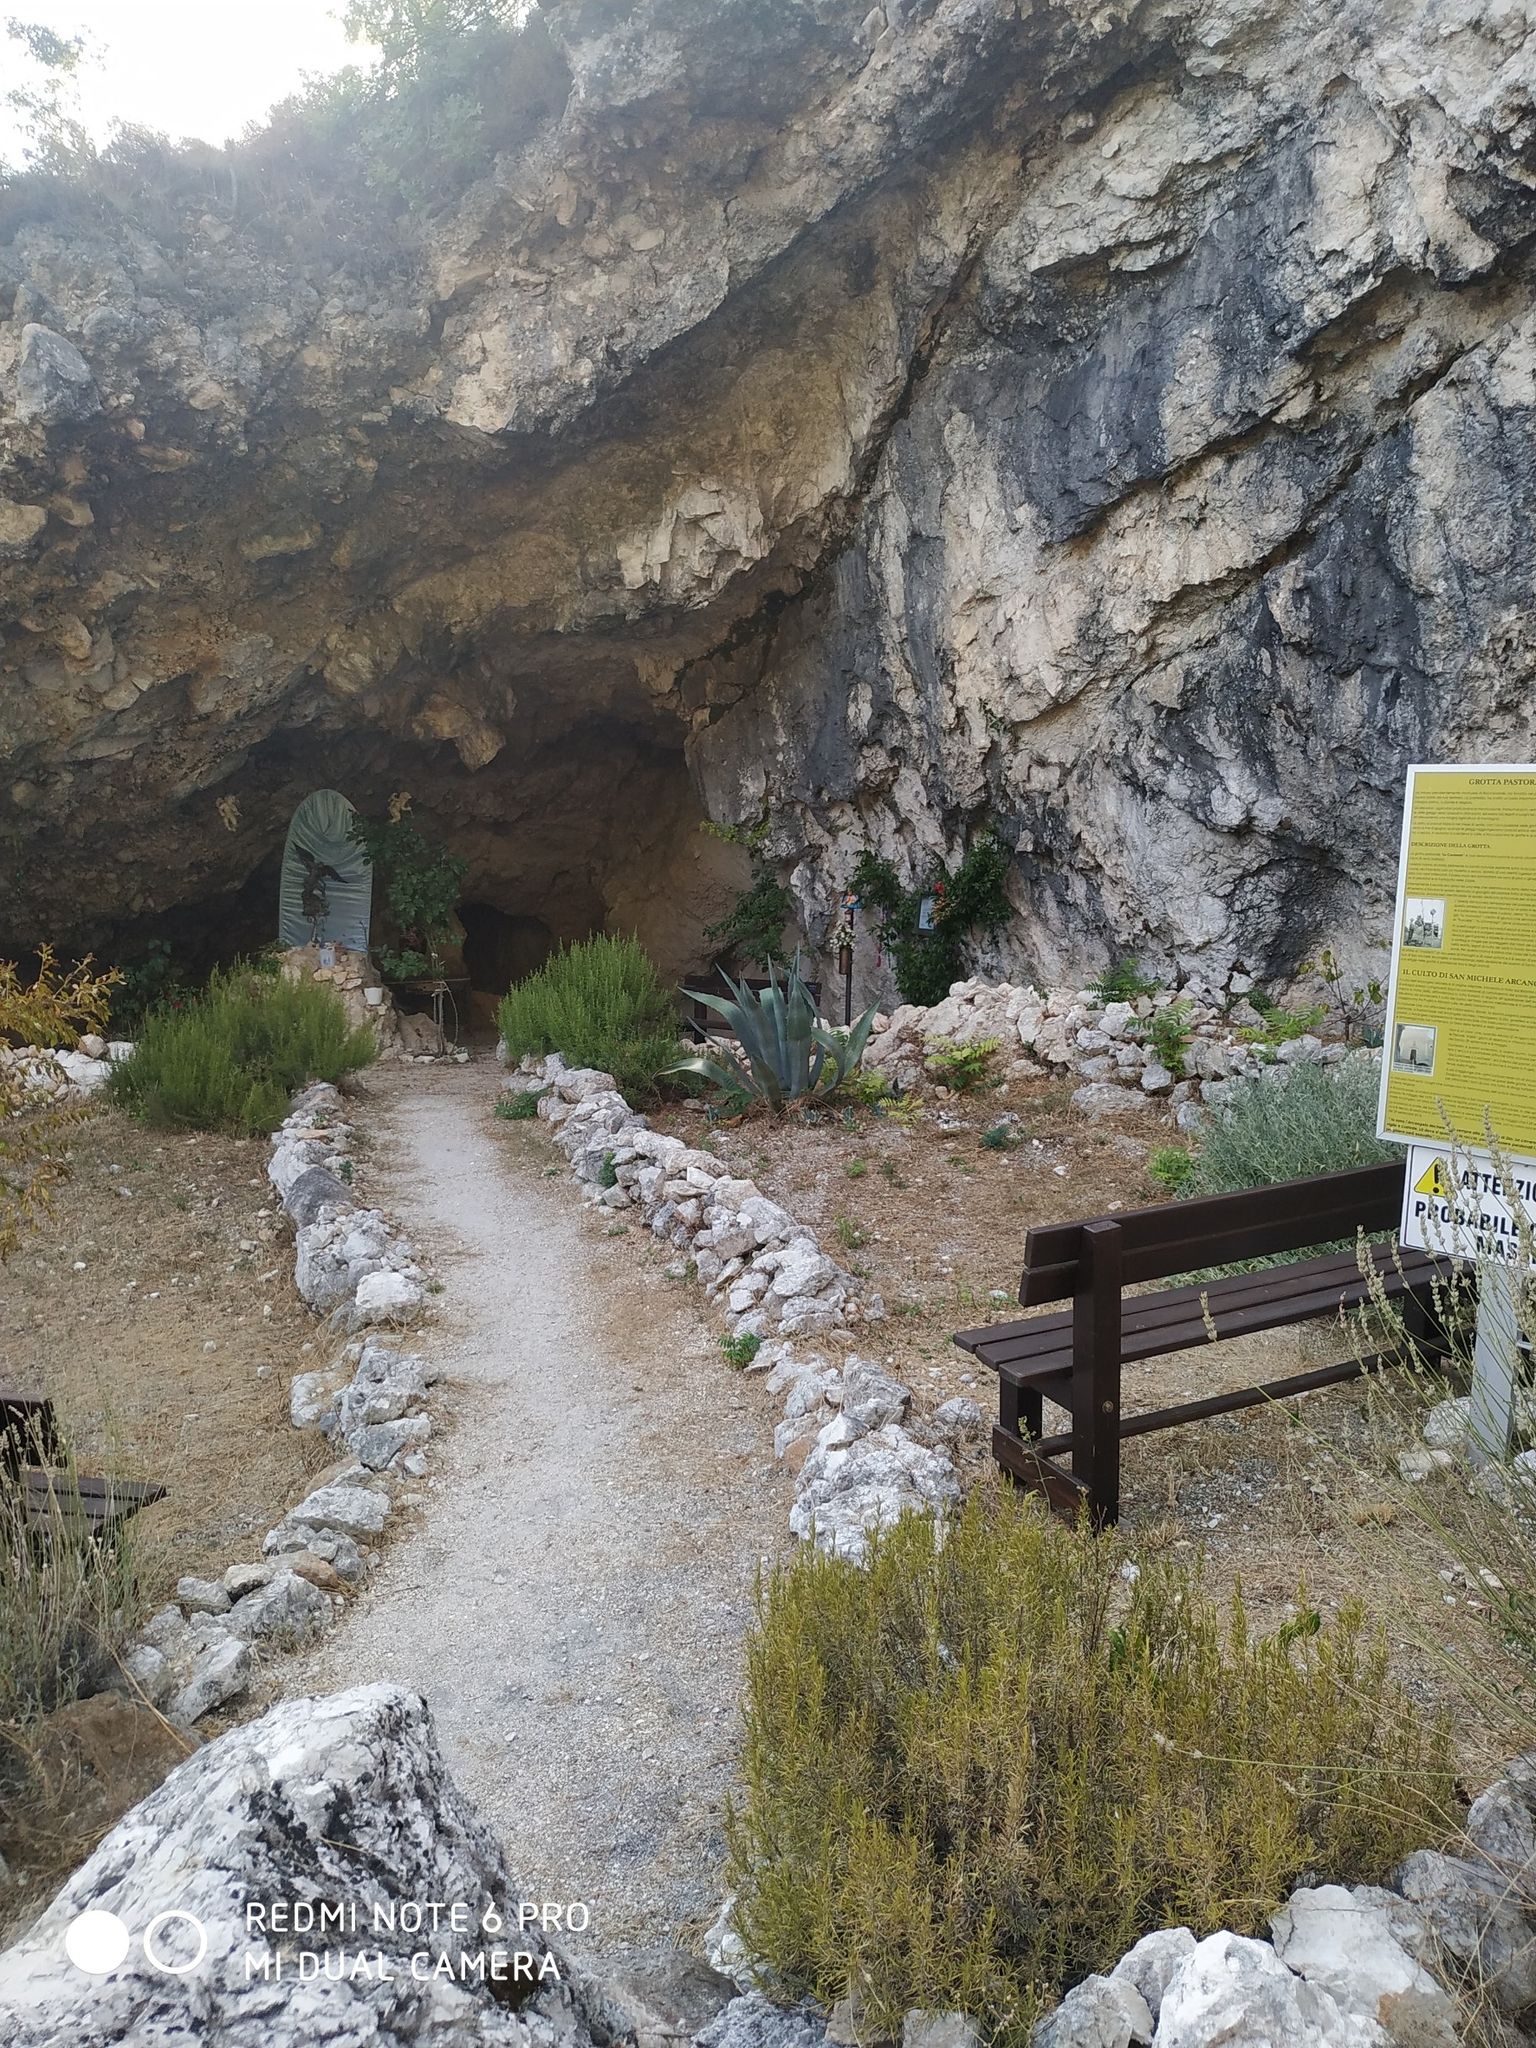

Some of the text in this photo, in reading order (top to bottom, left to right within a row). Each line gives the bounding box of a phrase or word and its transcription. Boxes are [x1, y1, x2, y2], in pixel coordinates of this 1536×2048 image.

[1468, 778, 1502, 786] GROTTA
[1402, 968, 1411, 976] IL
[1411, 969, 1438, 978] CULTO
[1439, 971, 1448, 979] DI
[1449, 973, 1465, 981] SAN
[1466, 974, 1504, 984] MICHELE
